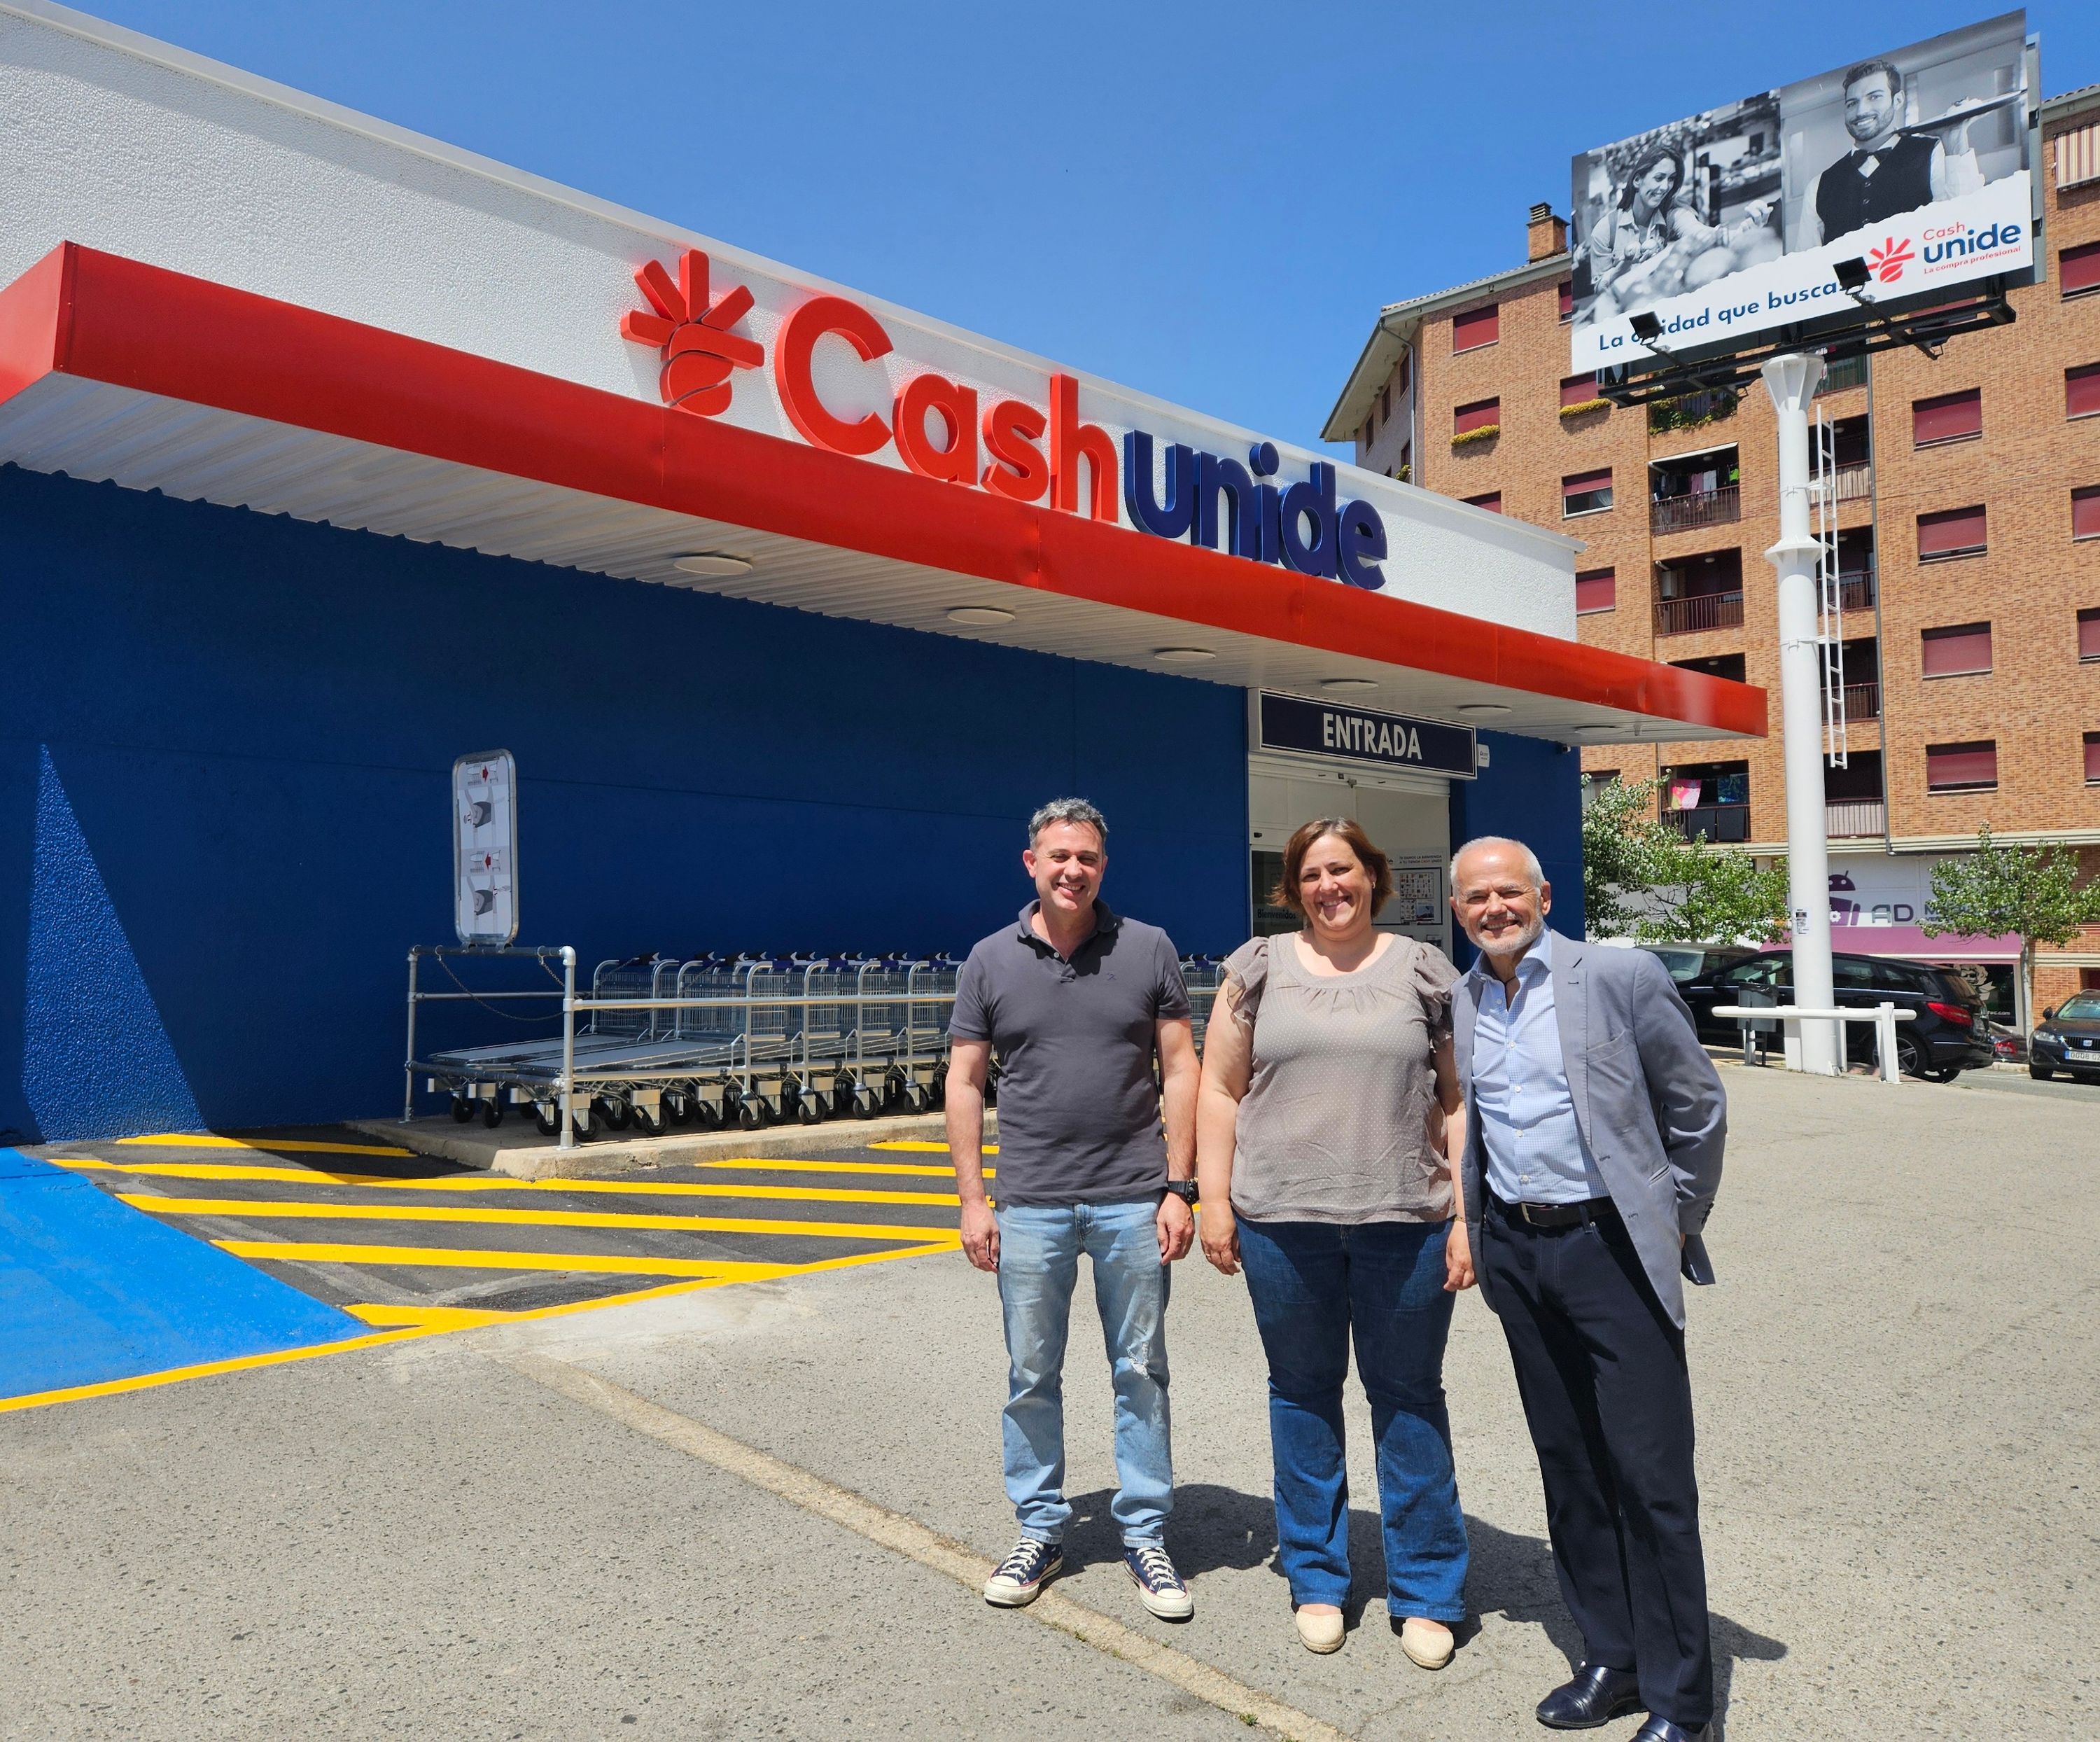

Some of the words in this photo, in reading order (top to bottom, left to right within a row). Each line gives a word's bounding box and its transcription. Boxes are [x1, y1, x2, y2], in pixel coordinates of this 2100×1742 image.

[1924, 222, 1966, 241] Cash
[1924, 223, 2022, 264] unide
[1936, 260, 1968, 272] compra
[1970, 246, 2021, 265] profesional
[1600, 335, 1623, 350] La
[1631, 307, 1709, 342] cidad
[1718, 302, 1759, 325] que
[1768, 281, 1844, 309] busca
[774, 295, 1119, 524] Cash
[1123, 429, 1388, 591] unide
[1323, 712, 1423, 760] ENTRADA
[1872, 904, 1914, 923] AD
